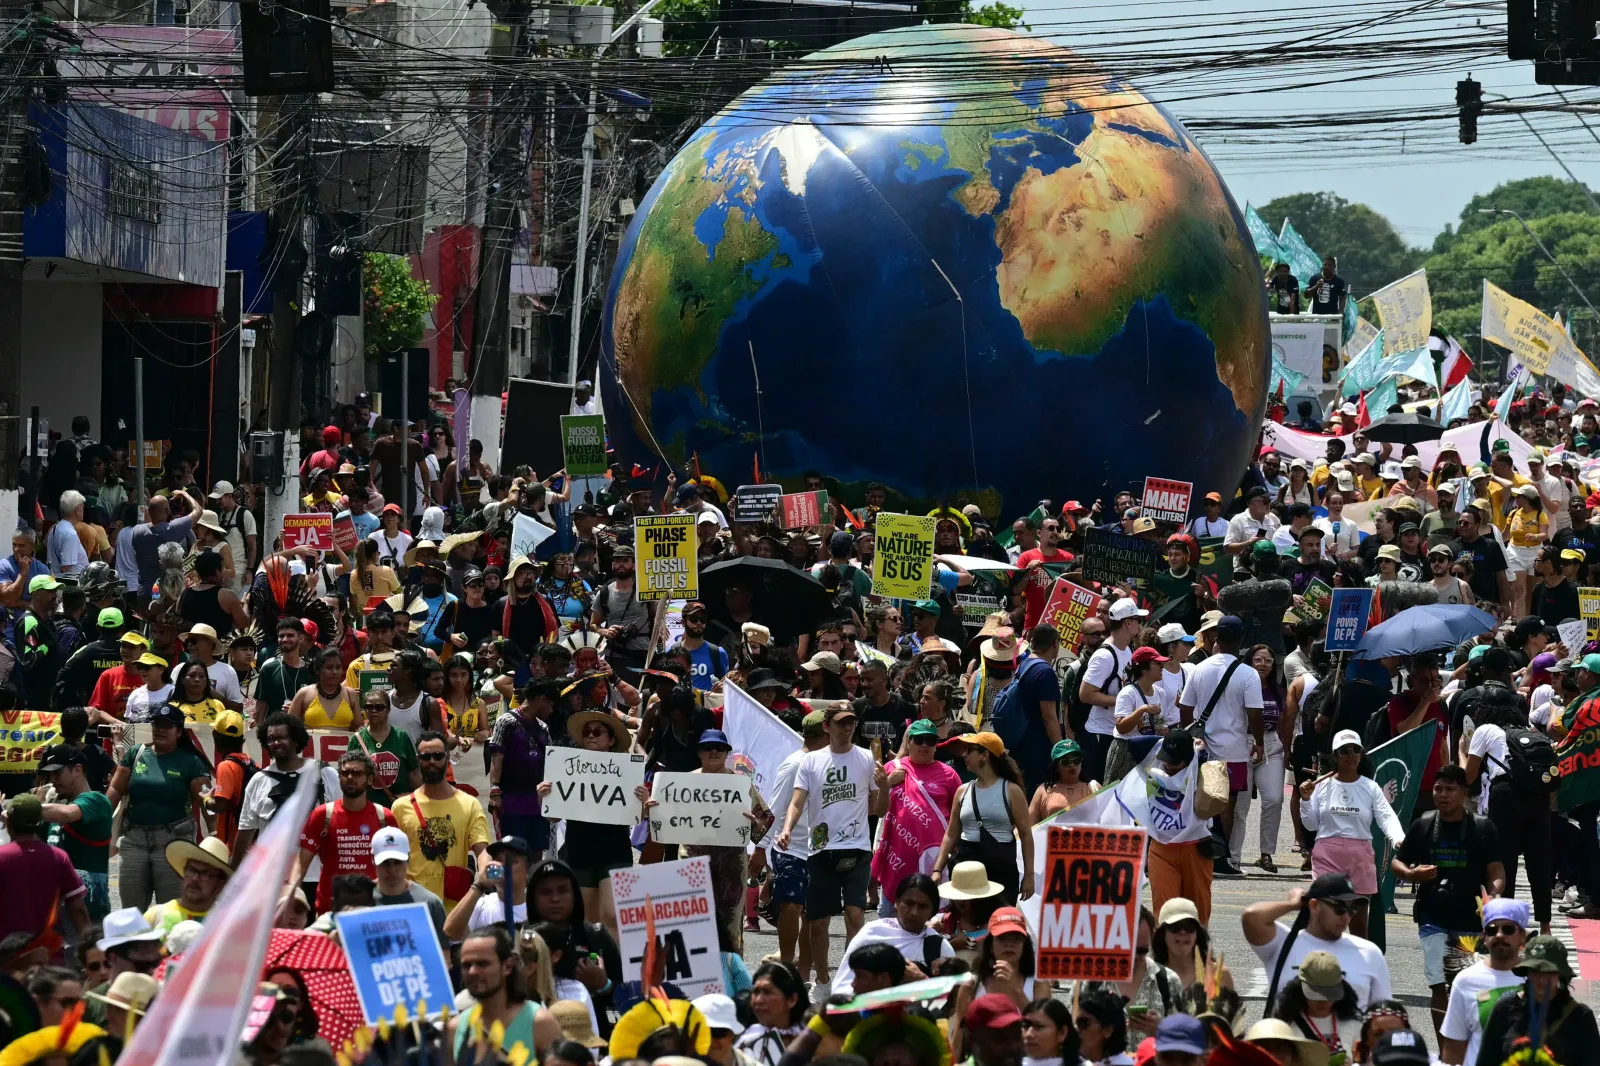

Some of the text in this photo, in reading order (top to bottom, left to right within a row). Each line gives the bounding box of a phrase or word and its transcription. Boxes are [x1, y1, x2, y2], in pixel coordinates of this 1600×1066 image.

[569, 426, 597, 436] NOSSO
[568, 435, 600, 446] FUTURO
[575, 454, 603, 465] VENDA
[1145, 489, 1188, 512] MAKE
[667, 515, 694, 523] FOREVER
[1143, 508, 1185, 523] POLLUTERS
[645, 527, 687, 543] PHASE
[891, 531, 903, 539] WE
[653, 543, 679, 558] OUT
[877, 536, 932, 557] NATURE
[881, 552, 927, 563] THE ANSWER
[645, 558, 689, 574] FOSSIL
[882, 559, 922, 582] IS US
[648, 574, 687, 590] FUELS
[640, 592, 655, 601] FAST
[672, 590, 697, 599] OREVER
[957, 594, 968, 602] COP
[969, 595, 978, 603] DA
[1071, 588, 1094, 607] END
[1067, 600, 1089, 619] THE
[1581, 598, 1600, 614] COP
[1054, 610, 1082, 631] FOSS
[1335, 617, 1359, 628] POVOS
[1056, 625, 1080, 645] FUEL
[1334, 627, 1357, 641] DE PÉ
[690, 663, 708, 676] 50
[564, 754, 623, 778] Floresta
[826, 765, 848, 785] EU
[556, 781, 627, 807] VIVA
[661, 781, 743, 804] FLORESTA
[700, 810, 723, 829] PÉ
[337, 834, 370, 842] TRANSIÇÃO
[1045, 858, 1134, 905] AGRO
[620, 896, 709, 926] DEMRCAÇÃO
[1040, 904, 1131, 950] MATA
[371, 956, 424, 982] POVOS
[377, 980, 406, 1006] DE
